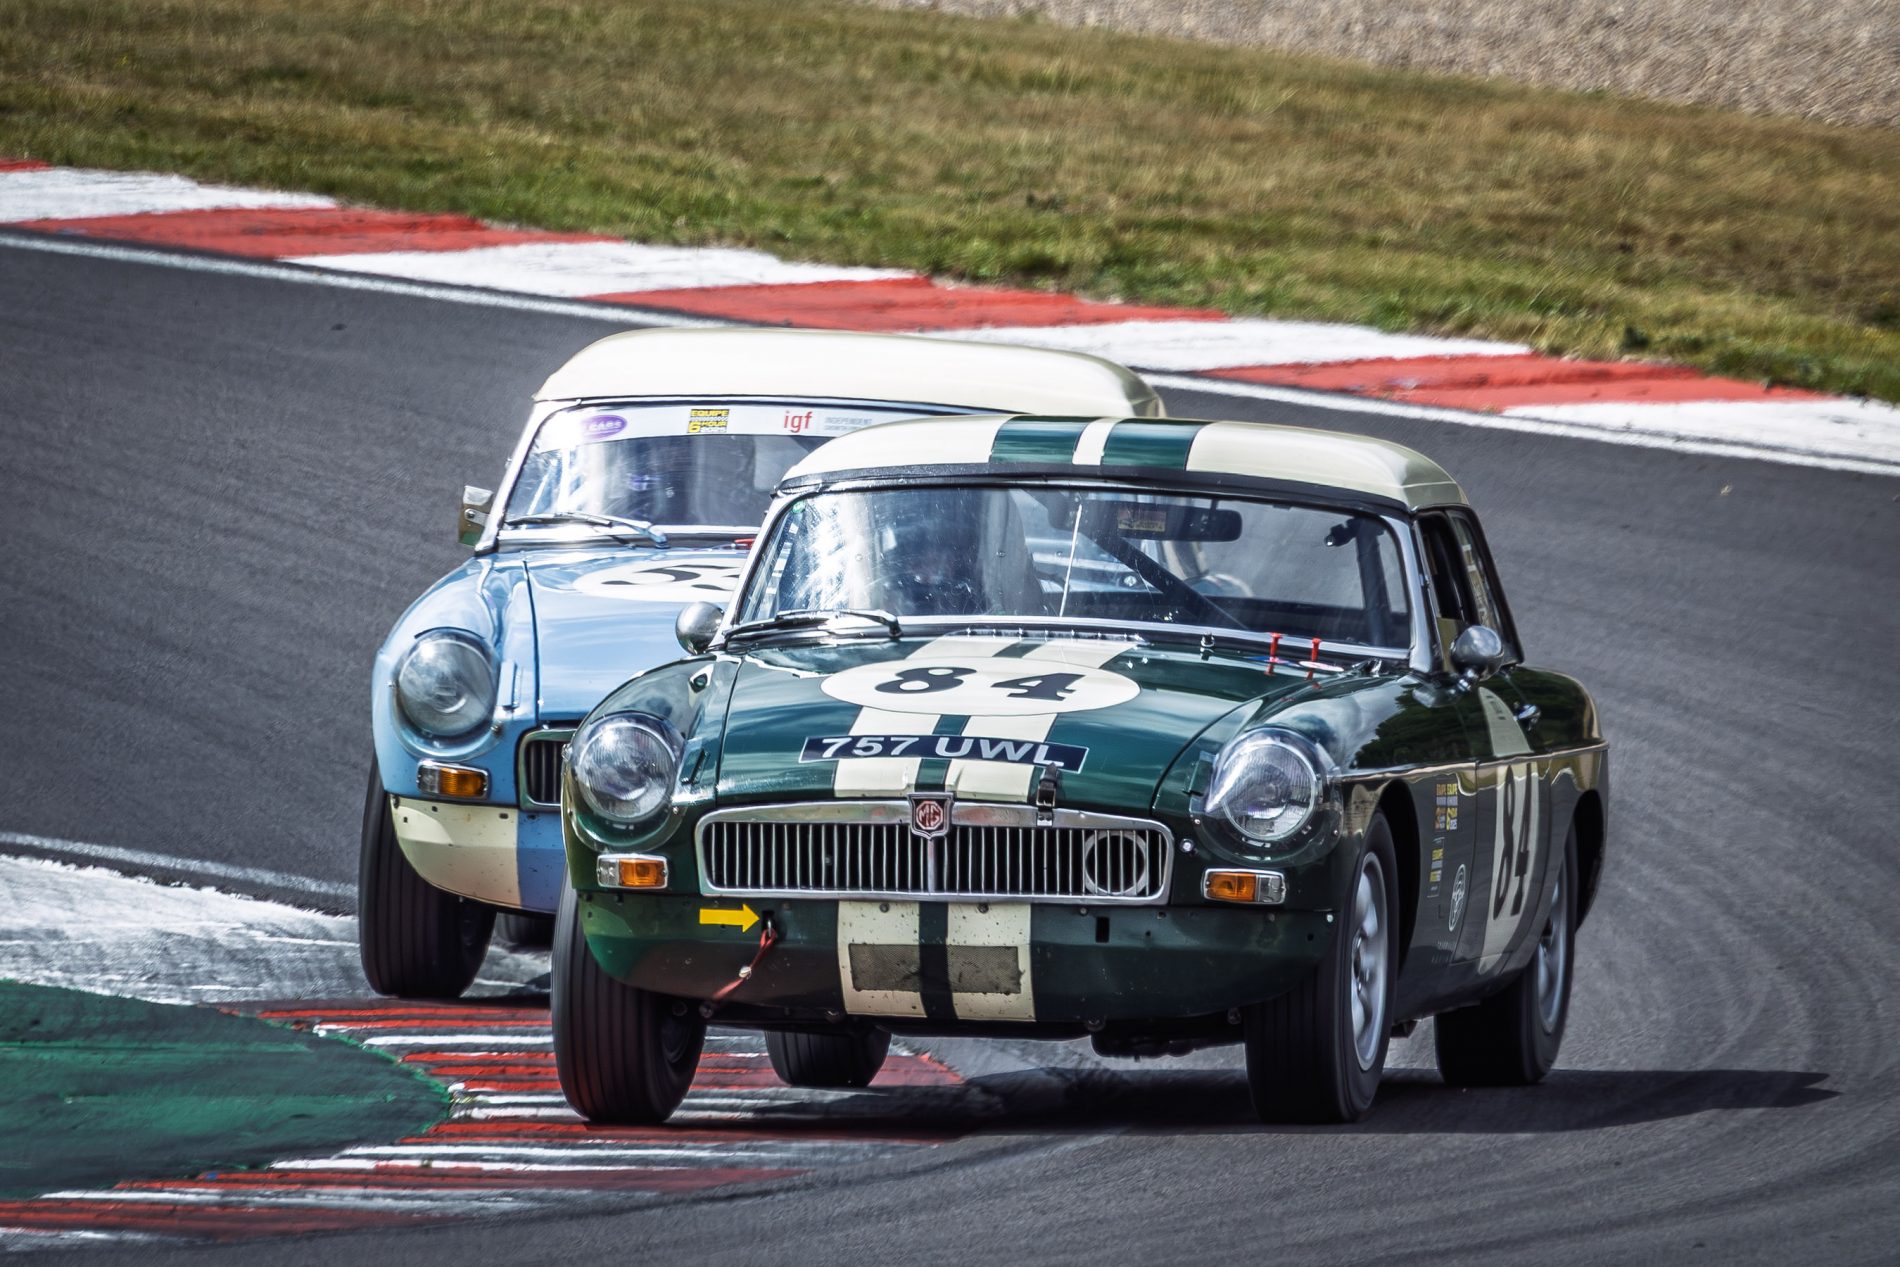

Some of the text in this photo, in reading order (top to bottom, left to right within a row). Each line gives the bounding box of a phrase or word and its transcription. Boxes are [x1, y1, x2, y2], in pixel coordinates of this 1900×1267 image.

[691, 409, 729, 417] EQUIPE
[783, 410, 813, 434] igf
[688, 421, 701, 433] 6
[875, 667, 1086, 701] 84
[822, 737, 1065, 768] 757 UWL
[918, 803, 941, 828] MG
